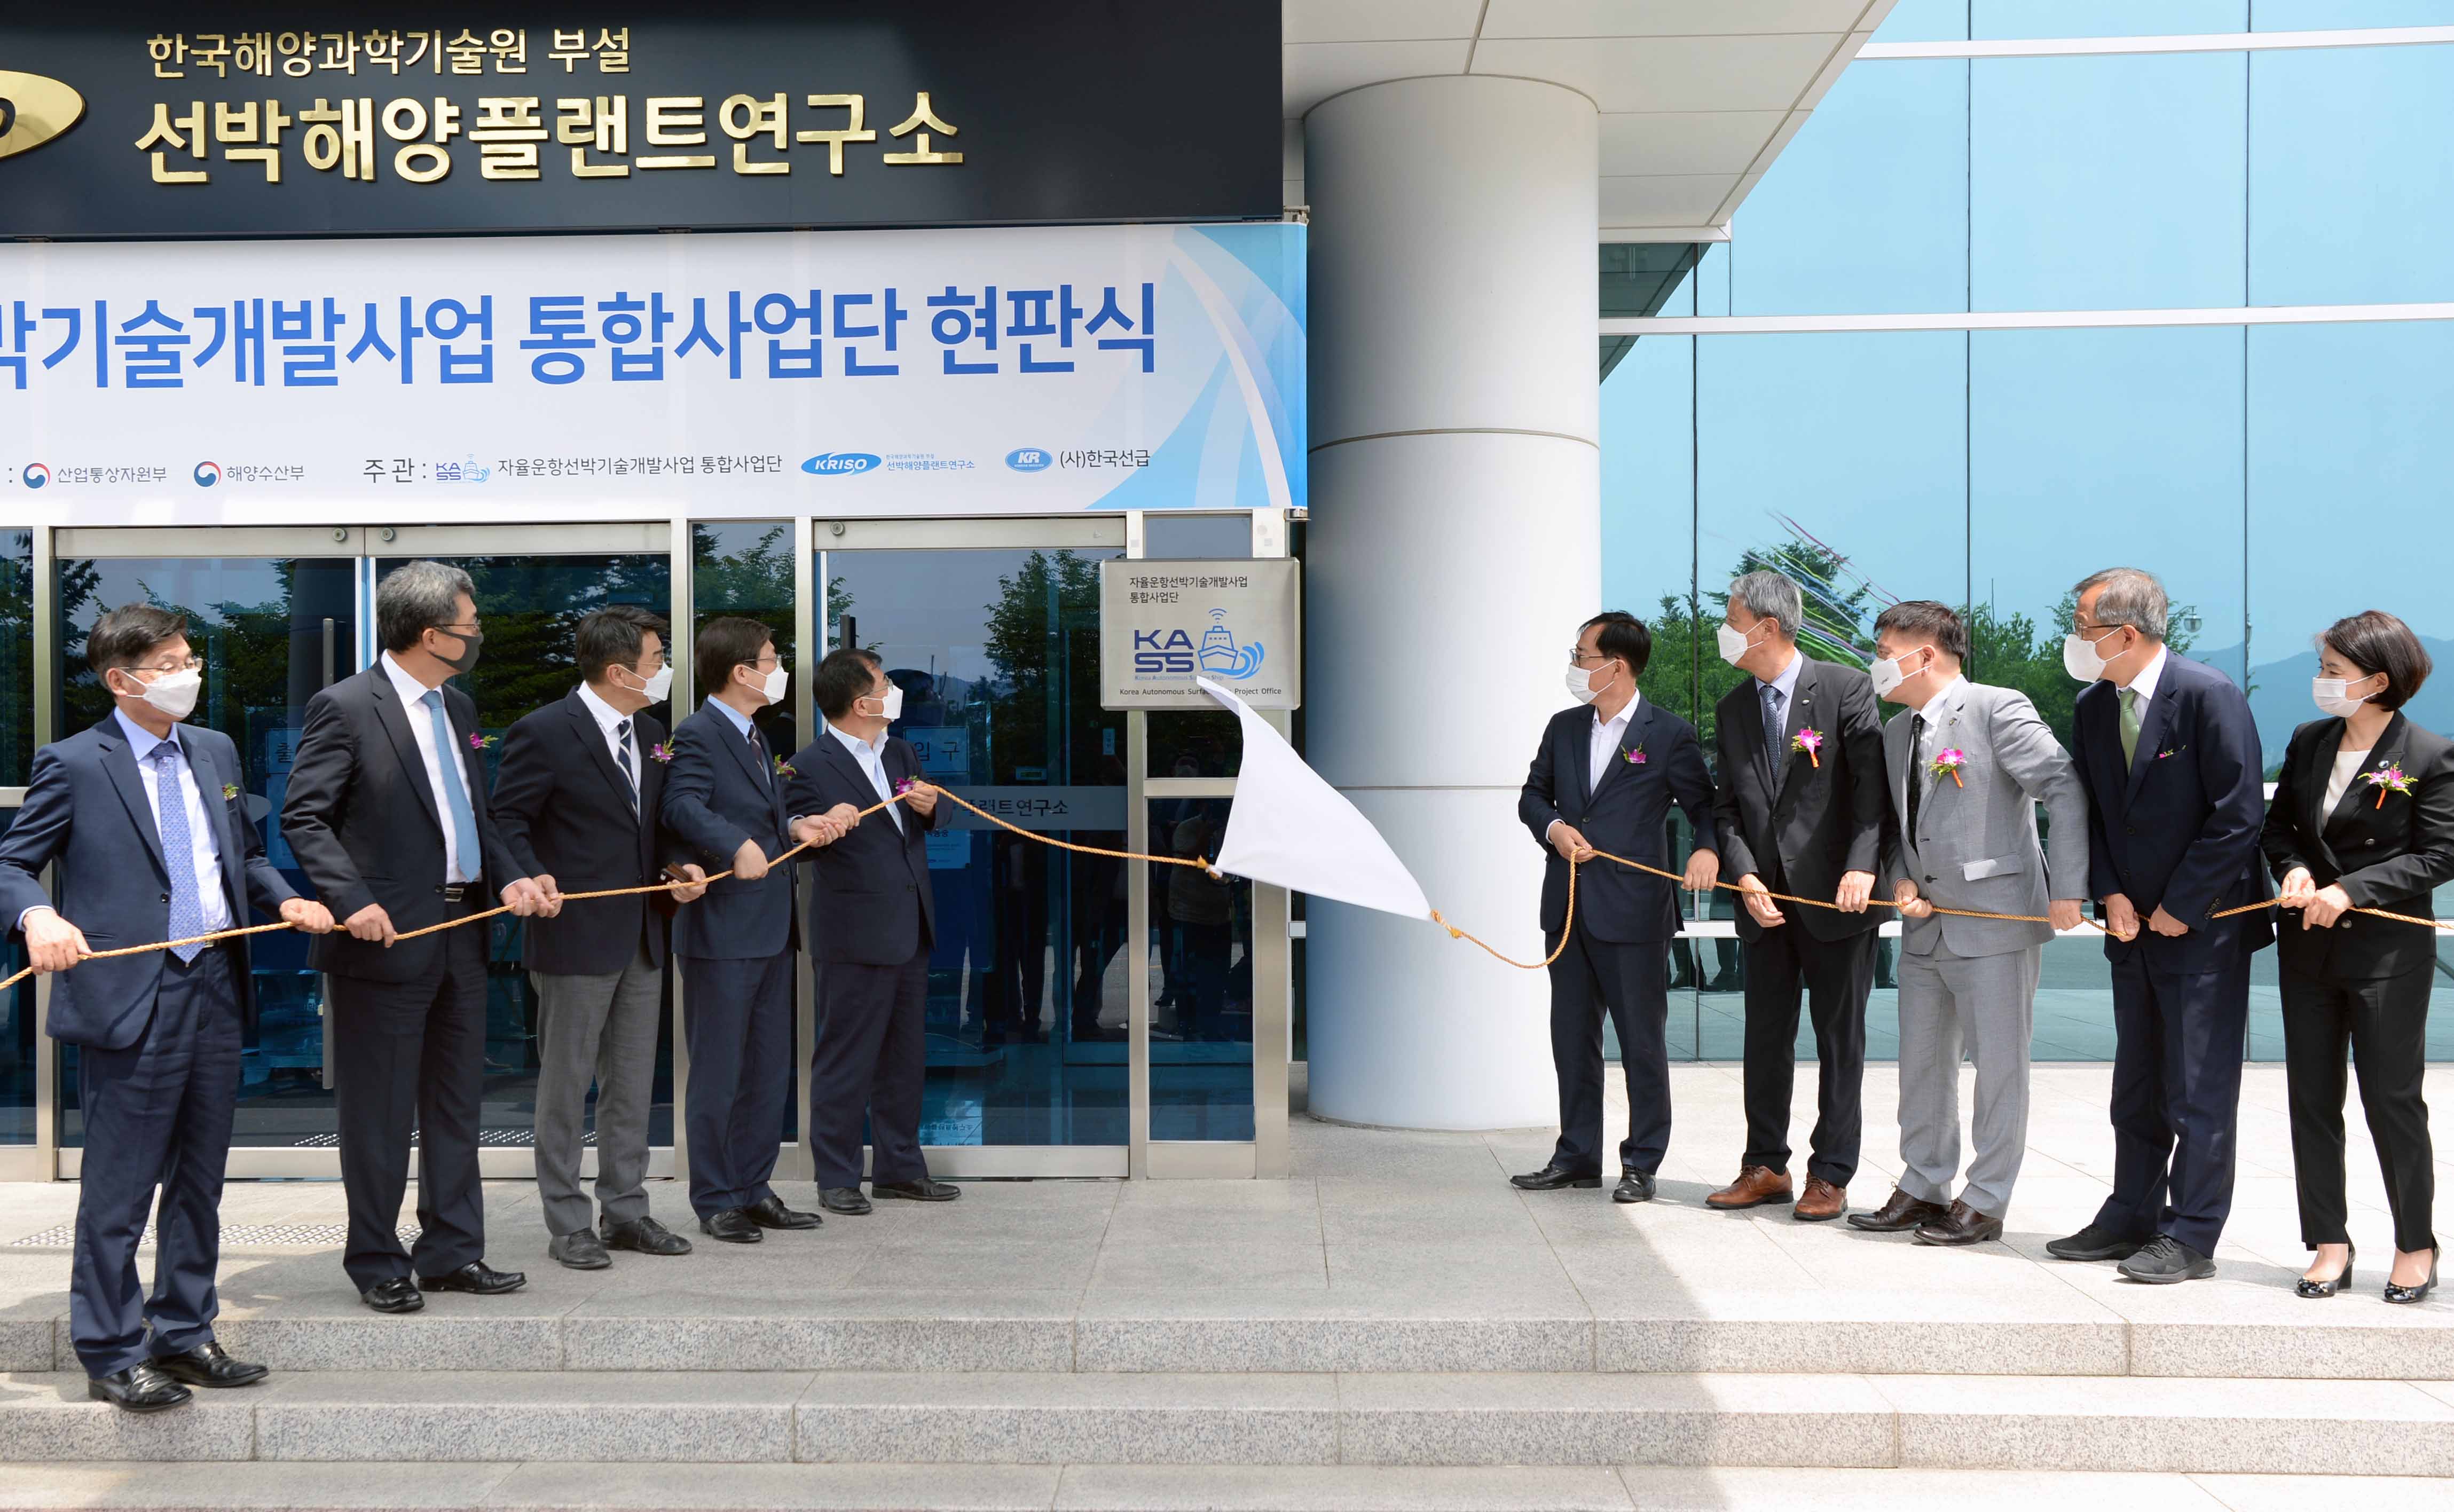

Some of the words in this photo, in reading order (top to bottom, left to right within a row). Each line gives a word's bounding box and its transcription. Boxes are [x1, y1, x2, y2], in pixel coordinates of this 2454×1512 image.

[147, 29, 527, 78] 한국해양과학기술원
[548, 28, 631, 73] 부설
[135, 92, 963, 183] 선박해양플랜트연구소
[520, 288, 908, 385] 통합사업단
[927, 282, 1154, 375] 현판식
[498, 456, 694, 476] 자율운항선박기술개발사업
[700, 455, 782, 474] 통합사업단
[815, 459, 867, 470] KRISO
[887, 460, 975, 471] 선박해양플랜트연구소
[1018, 452, 1041, 463] KR
[1060, 449, 1151, 469] (사)한국선급
[58, 467, 167, 484] 산업통상자원부
[226, 465, 304, 482] 해양수산부
[1129, 576, 1247, 588] 자율운항선박기술개발사업
[1129, 591, 1179, 604] 통합사업단
[1234, 688, 1259, 696] Project
